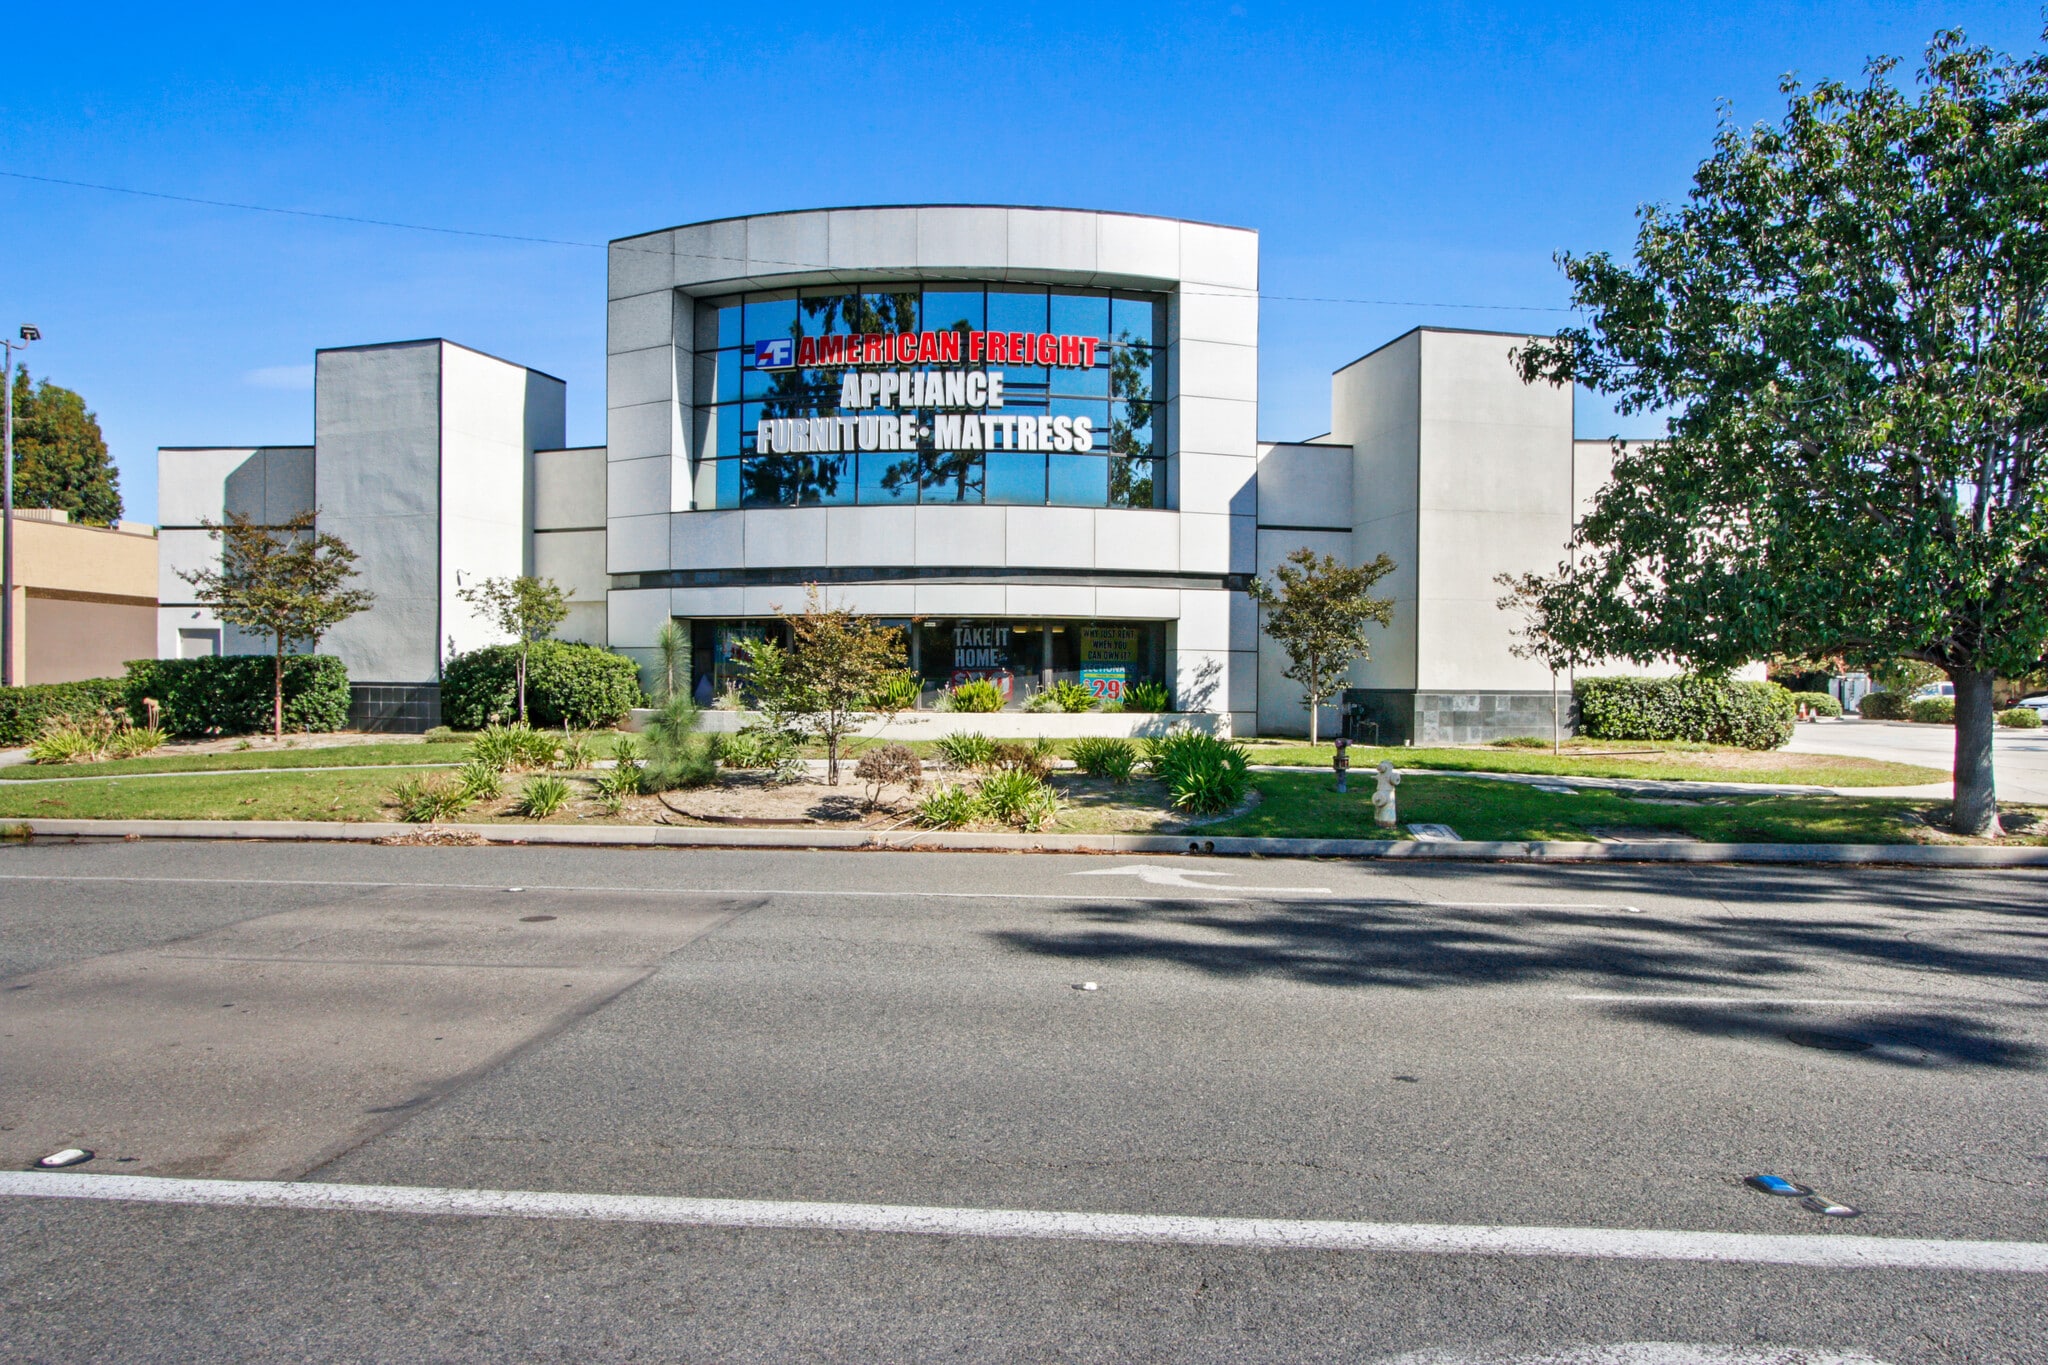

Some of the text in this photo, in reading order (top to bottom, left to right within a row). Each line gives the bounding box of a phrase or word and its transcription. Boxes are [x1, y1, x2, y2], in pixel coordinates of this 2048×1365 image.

[757, 337, 792, 366] AF
[797, 331, 1100, 367] AMERICAN FREIGHT
[840, 371, 1004, 408] APPLIANCE
[757, 415, 1093, 454] FURNITURE MATTRESS
[953, 628, 1009, 646] TAKE IT
[1084, 629, 1098, 638] WHY
[1100, 630, 1115, 638] JUST
[1093, 640, 1127, 649] WHEN YOU
[954, 649, 998, 667] HOME
[1088, 651, 1102, 660] CAN
[1104, 651, 1118, 660] OWN
